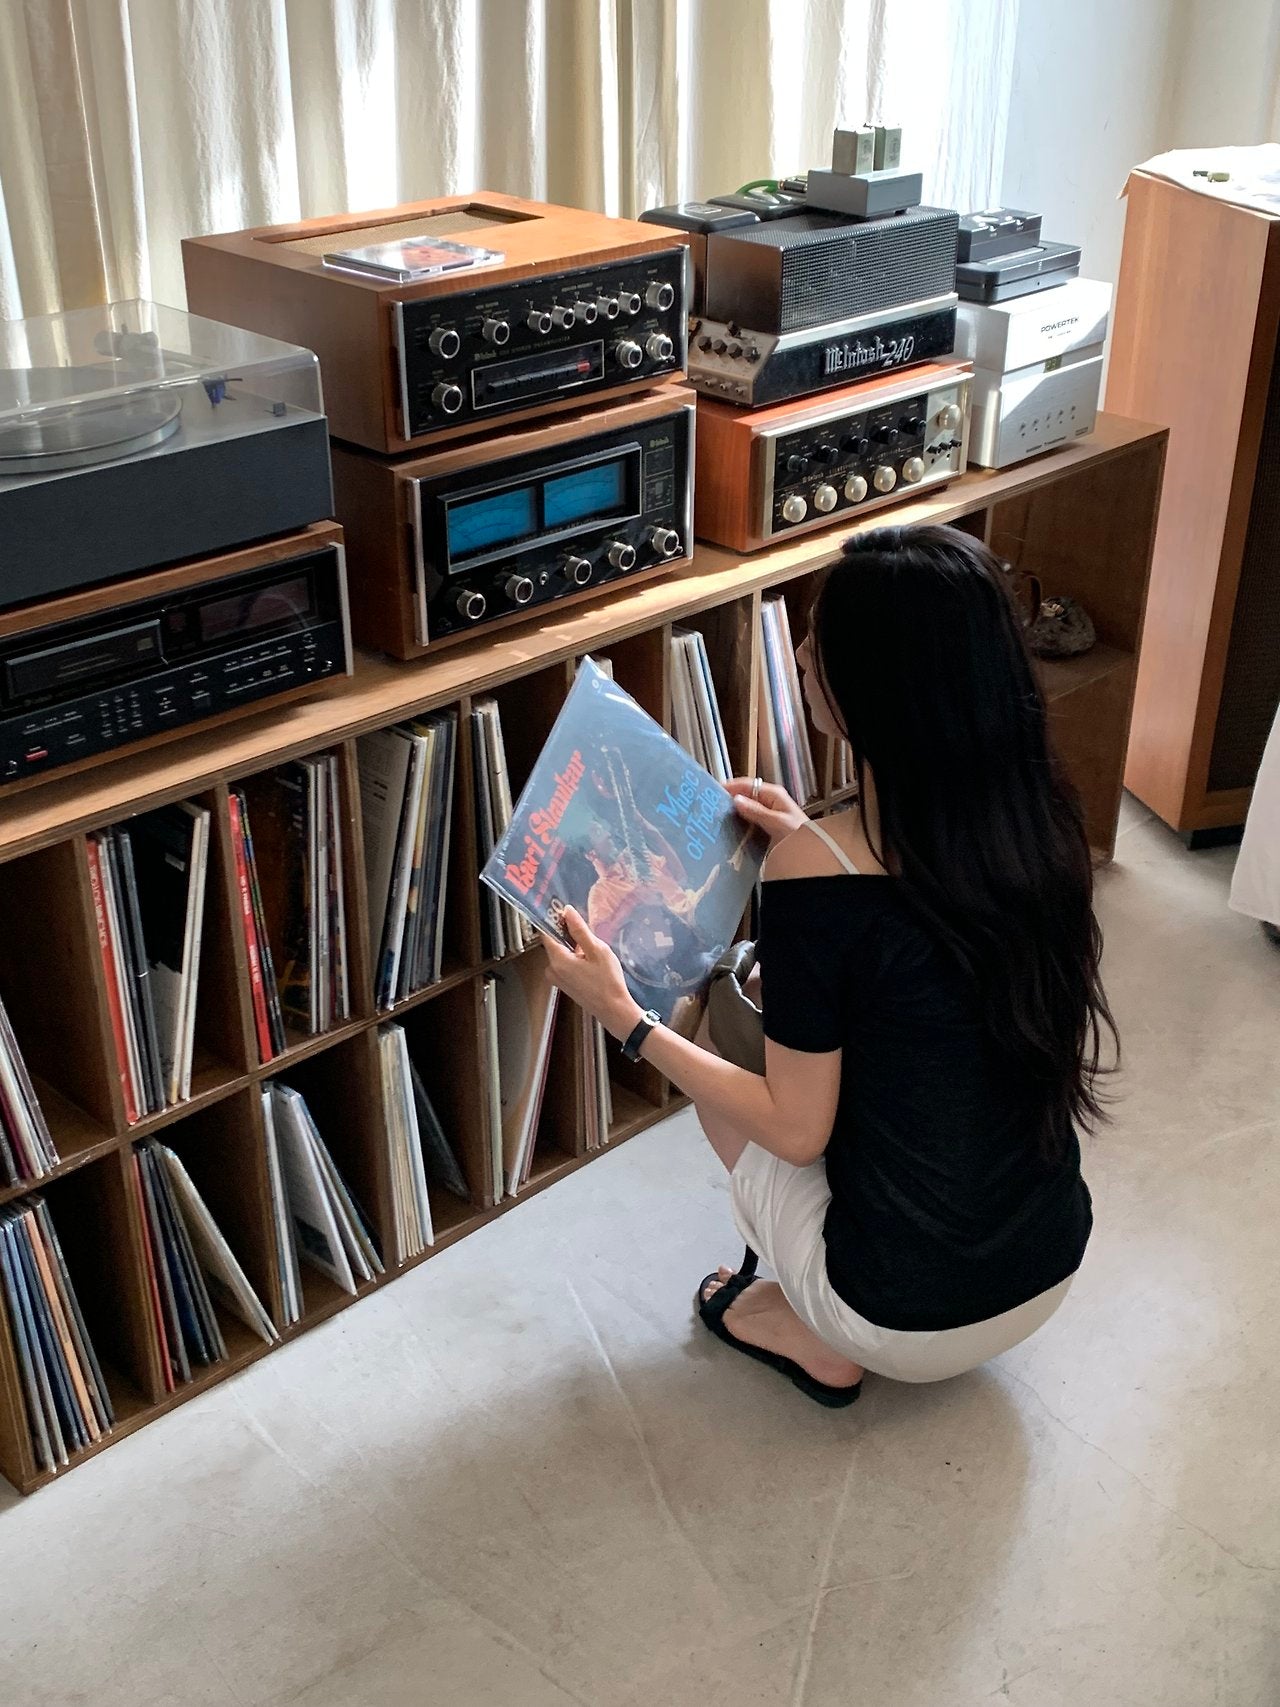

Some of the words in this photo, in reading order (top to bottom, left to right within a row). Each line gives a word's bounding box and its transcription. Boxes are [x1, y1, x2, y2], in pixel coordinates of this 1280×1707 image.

[880, 335, 914, 368] 240
[656, 768, 700, 828] Music
[687, 786, 722, 844] India
[684, 824, 706, 860] of
